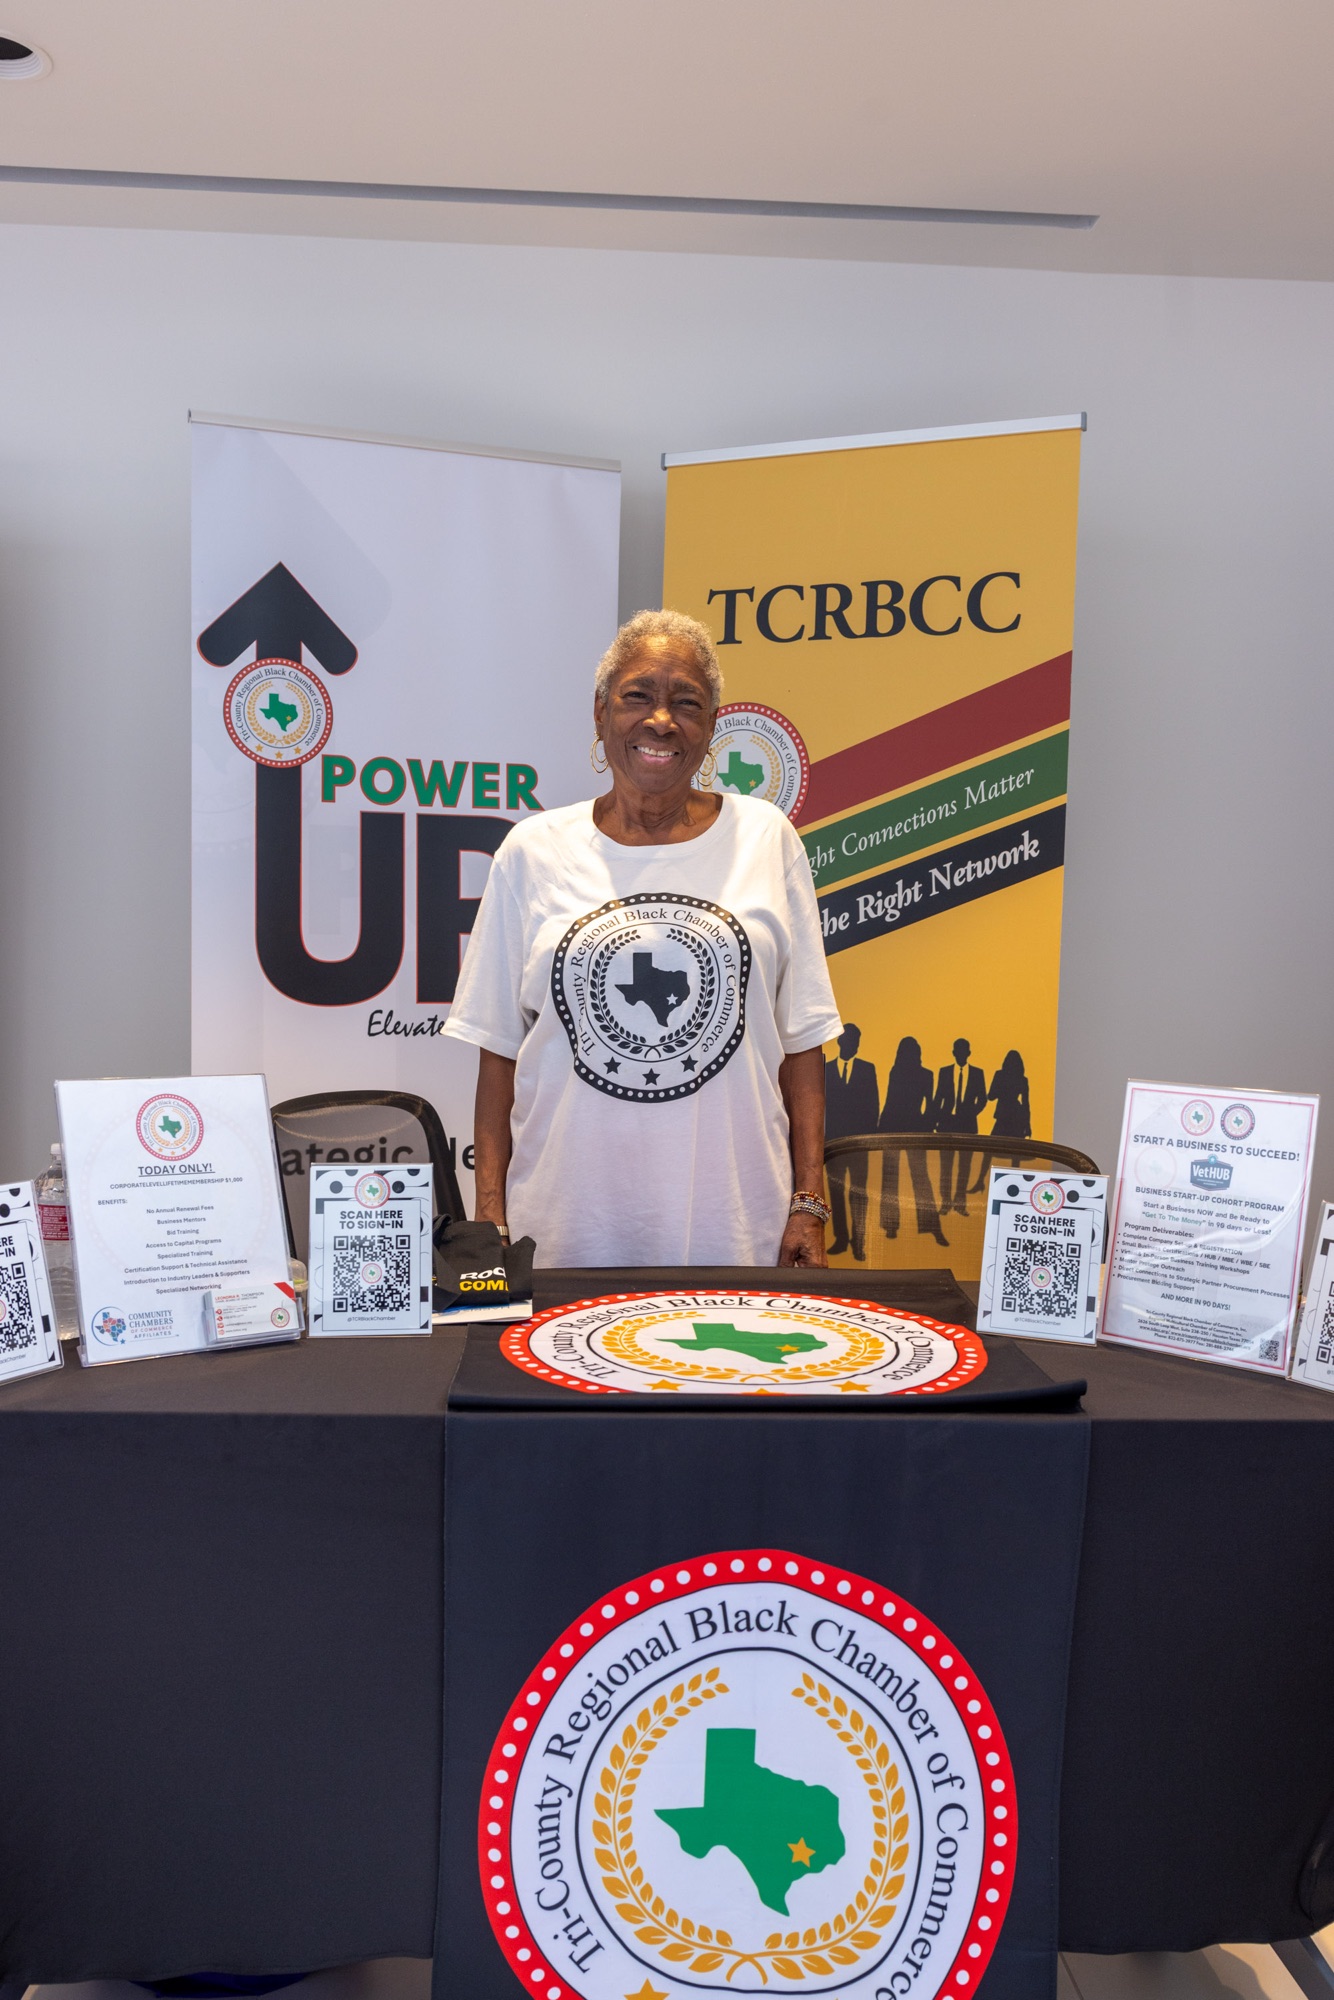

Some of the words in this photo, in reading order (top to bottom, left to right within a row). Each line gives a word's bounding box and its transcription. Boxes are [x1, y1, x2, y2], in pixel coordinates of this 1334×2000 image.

[706, 571, 1022, 645] TCRBCC
[264, 668, 286, 676] Black
[237, 671, 263, 698] Regional
[288, 671, 317, 698] Chamber
[314, 698, 322, 707] of
[235, 699, 251, 742] Tri-County
[305, 708, 323, 746] Commerce
[724, 717, 751, 729] Black
[754, 718, 789, 751] Chamber
[785, 753, 796, 763] of
[321, 754, 546, 810] POWER
[841, 802, 957, 857] Connections
[964, 769, 1034, 810] Matter
[856, 879, 922, 923] Right
[928, 830, 1040, 897] Network
[624, 908, 667, 922] Black
[673, 910, 729, 949] Chamber
[571, 916, 620, 968] Regional
[723, 954, 736, 970] of
[702, 974, 736, 1053] Commerce
[1133, 1134, 1165, 1146] START
[1166, 1139, 1174, 1147] A
[1176, 1139, 1227, 1153] BUSINESS
[1230, 1145, 1243, 1154] TO
[1245, 1148, 1300, 1162] SUCCEED!
[138, 1165, 176, 1176] TODAY
[179, 1163, 212, 1174] ONLY!
[1193, 1165, 1230, 1180] VetHUB
[1135, 1186, 1172, 1197] BUSINESS
[1173, 1191, 1210, 1202] START-UP
[1211, 1196, 1243, 1207] COHORT
[1244, 1201, 1285, 1212] PROGRAM
[340, 1210, 372, 1219] SCAN
[375, 1210, 403, 1219] HERE
[1014, 1214, 1048, 1226] SCAN
[1049, 1217, 1076, 1227] HERE
[1143, 1201, 1159, 1209] Start
[1166, 1205, 1195, 1214] Business
[1240, 1215, 1260, 1224] Ready
[339, 1220, 355, 1229] TO
[357, 1220, 403, 1229] SIGN-IN
[1013, 1223, 1028, 1233] TO
[1031, 1225, 1075, 1237] SIGN-IN
[1124, 1222, 1150, 1231] Program
[1153, 1227, 1194, 1238] Deliverables:
[0, 1236, 13, 1247] RE
[174, 1240, 194, 1248] Capital
[1123, 1233, 1147, 1241] Complete
[1149, 1236, 1173, 1245] Company
[124, 1264, 160, 1273] Certification
[1161, 1264, 1185, 1272] Outreach
[1196, 1261, 1218, 1270] Training
[1219, 1265, 1250, 1274] Workshops
[124, 1277, 159, 1285] Introduction
[220, 1270, 250, 1278] Supporters
[460, 1280, 509, 1291] COM
[1117, 1274, 1150, 1283] Procurement
[1151, 1279, 1172, 1288] Bidding
[1173, 1283, 1195, 1291] Support
[1135, 1268, 1167, 1278] Connections
[1176, 1275, 1200, 1284] Strategic
[1223, 1283, 1259, 1294] Procurement
[1260, 1289, 1290, 1299] Processes
[1176, 1296, 1193, 1304] MORE
[1212, 1302, 1230, 1311] DAYS!
[128, 1310, 172, 1320] COMMUNITY
[129, 1318, 173, 1328] CHAMBERS
[556, 1303, 661, 1329] Regional
[668, 1297, 755, 1307] Black
[766, 1298, 888, 1325] Chamber
[886, 1324, 924, 1335] of
[134, 1331, 171, 1339] AFFILIATES
[684, 1600, 799, 1643] Black
[810, 1617, 938, 1744] Chamber
[543, 1622, 681, 1765] Regional
[927, 1751, 966, 1793] of
[535, 1775, 606, 1974] Tri-County
